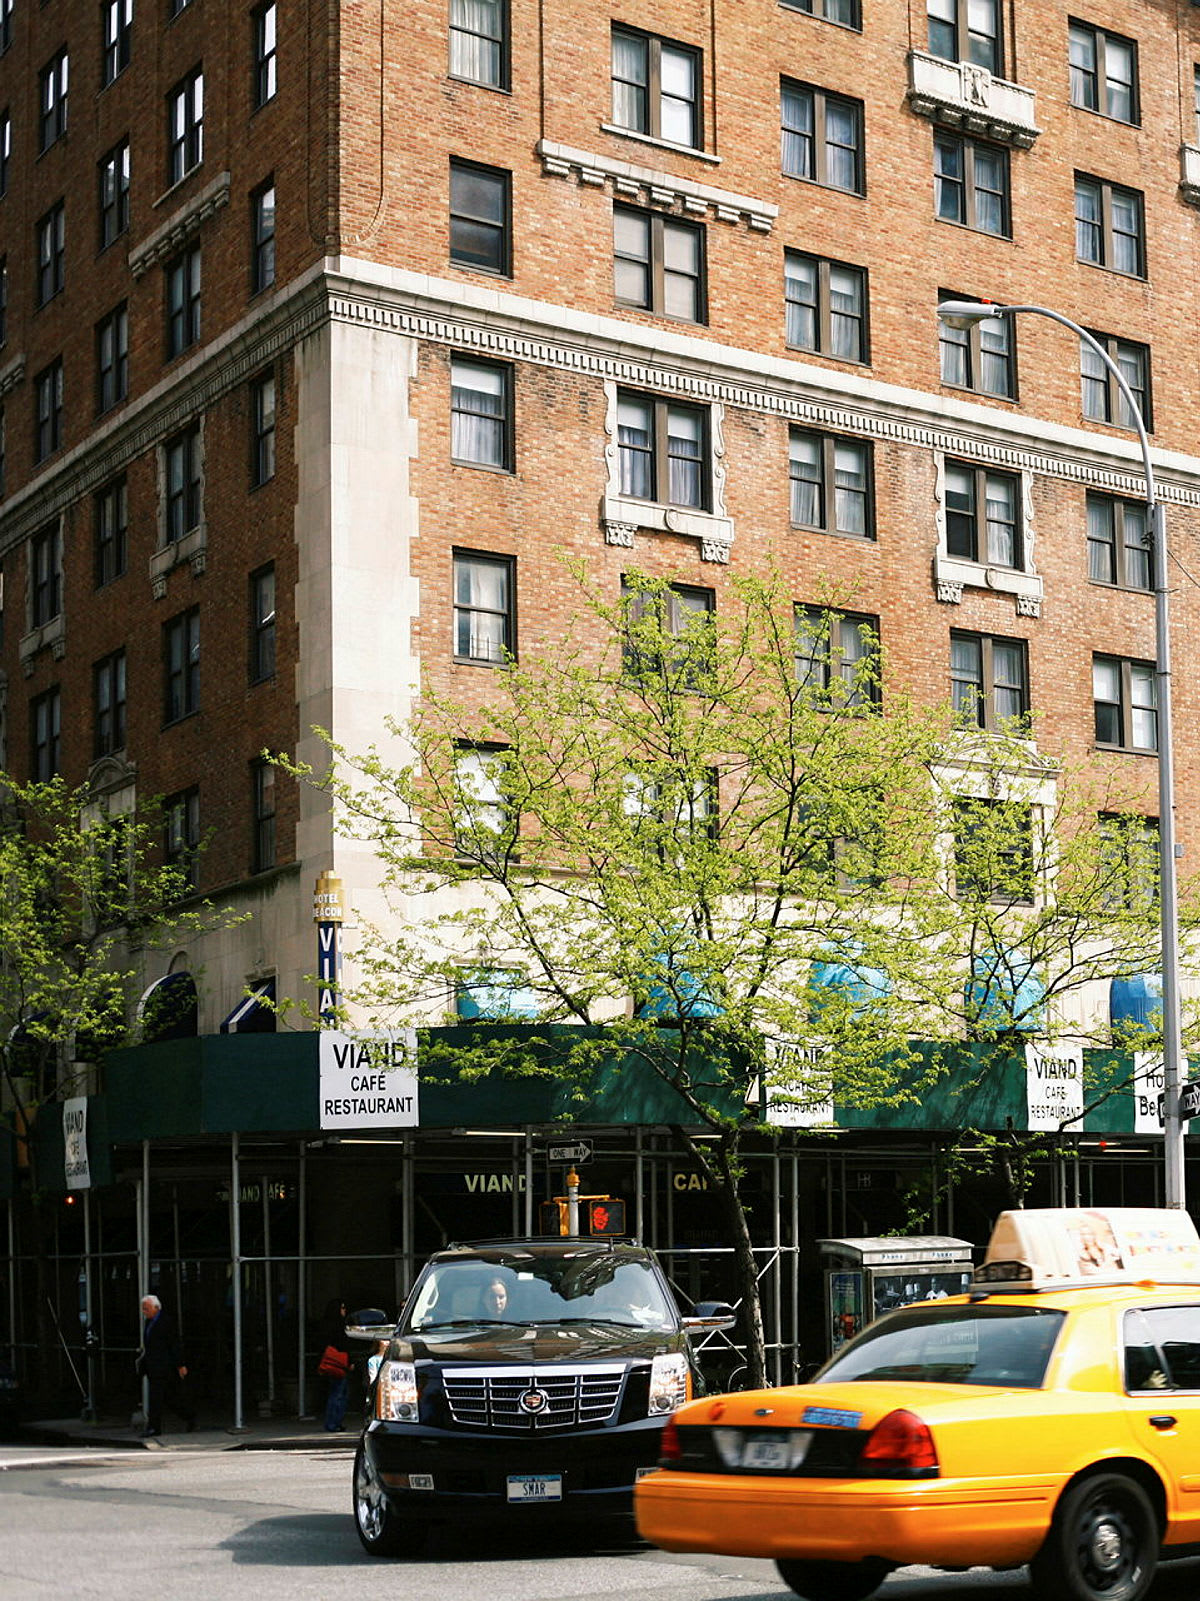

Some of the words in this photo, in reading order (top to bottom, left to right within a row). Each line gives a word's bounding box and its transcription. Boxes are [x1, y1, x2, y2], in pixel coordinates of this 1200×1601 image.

[332, 1042, 407, 1069] VIAND
[1033, 1058, 1077, 1079] VIAND
[350, 1071, 386, 1092] CAFÉ
[324, 1096, 413, 1116] RESTAURANT
[1031, 1104, 1081, 1119] RESTAURANT
[552, 1148, 566, 1159] ONE
[573, 1147, 587, 1157] WAY
[464, 1174, 527, 1193] VIAND
